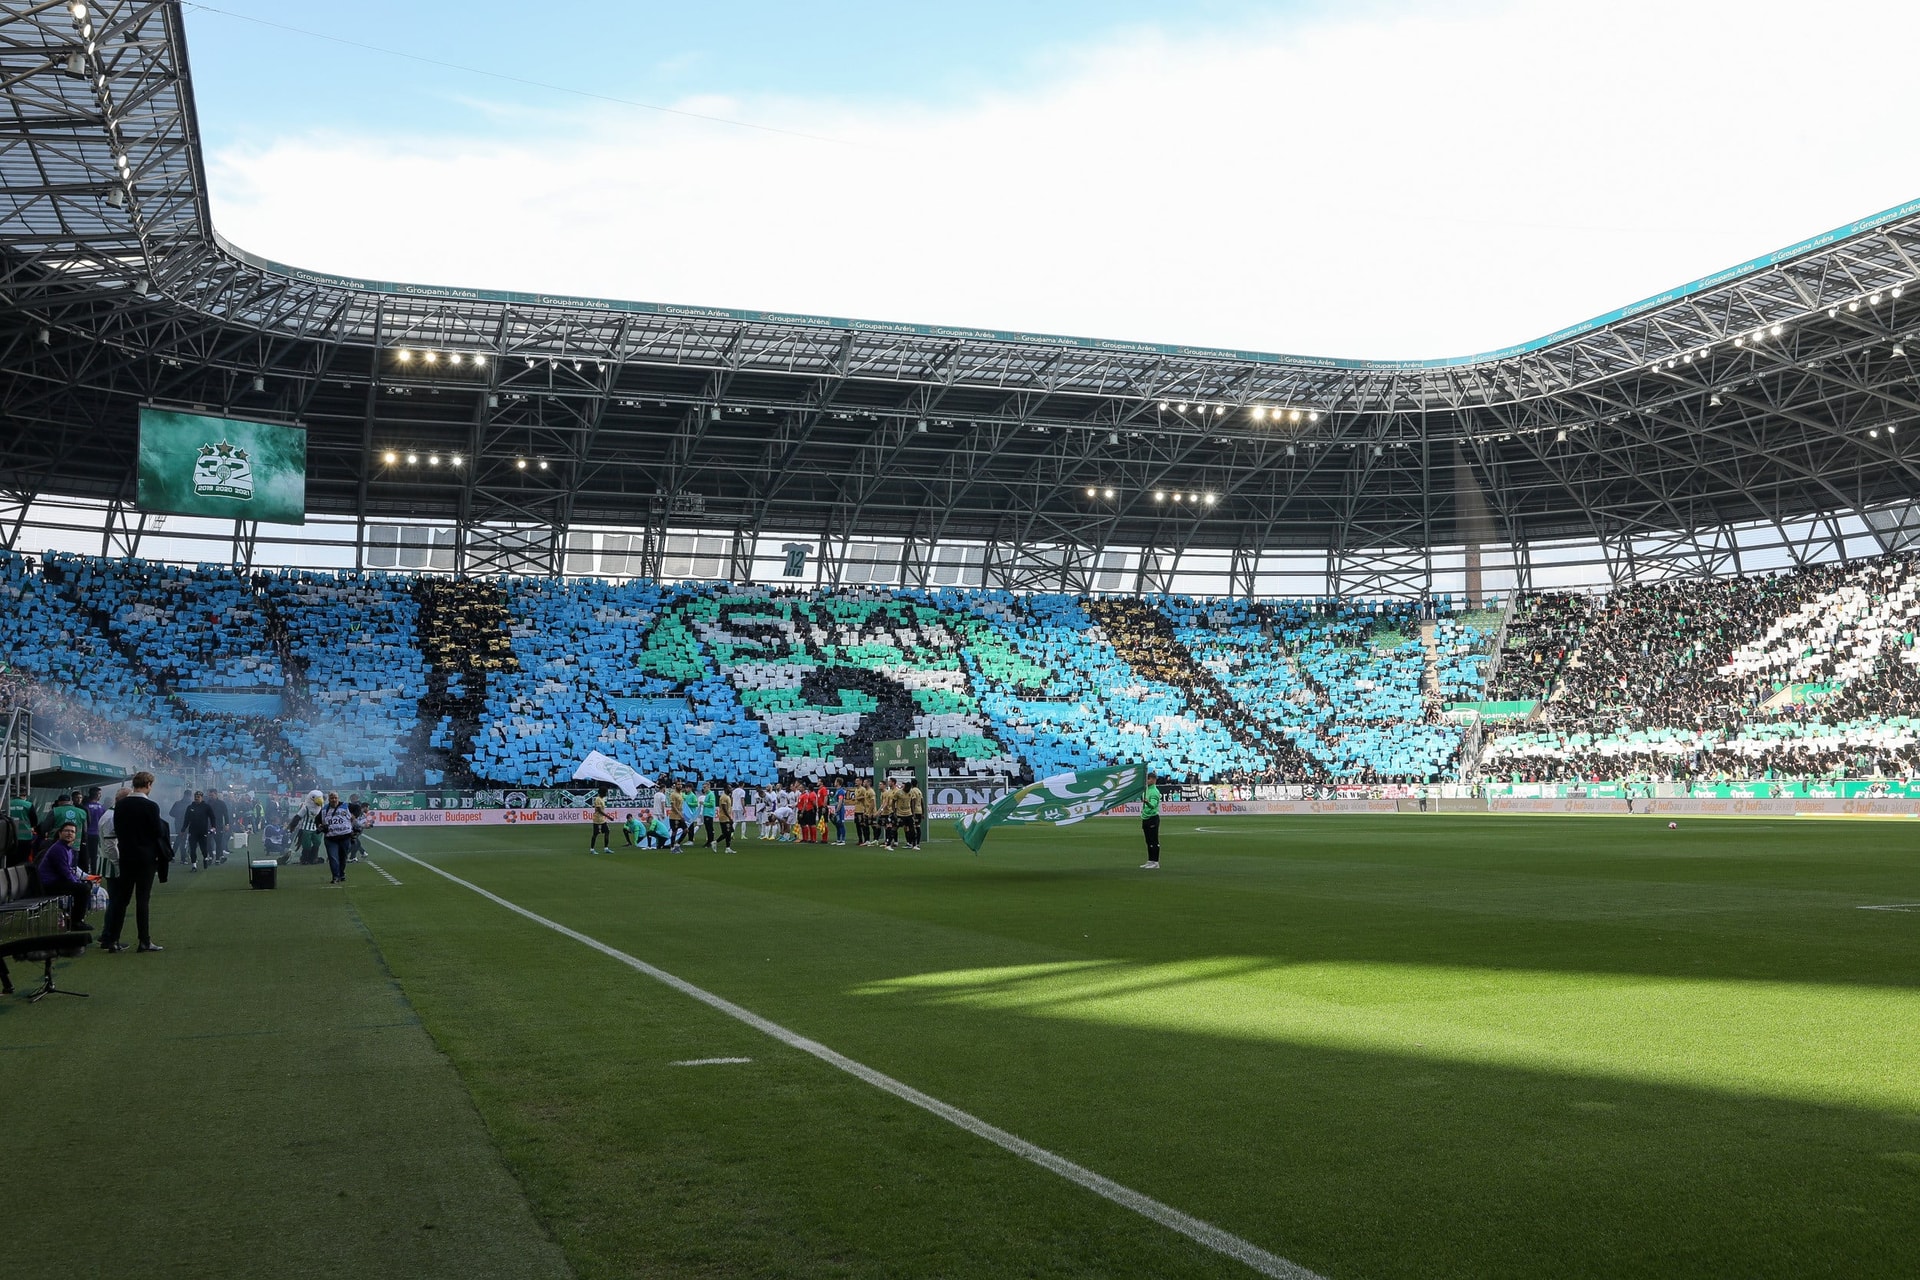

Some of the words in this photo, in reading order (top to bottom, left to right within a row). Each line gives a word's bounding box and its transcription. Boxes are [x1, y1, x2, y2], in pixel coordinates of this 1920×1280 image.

[1860, 212, 1898, 229] Groupama
[1778, 244, 1812, 259] Groupama
[297, 271, 338, 285] Groupama
[340, 279, 365, 288] Aréna
[1704, 271, 1736, 285] Groupama
[406, 286, 450, 296] Groupama
[452, 290, 477, 298] Aréna
[543, 297, 585, 307] Groupama
[586, 301, 610, 309] Aréna
[666, 307, 705, 316] Groupama
[769, 315, 807, 324] Groupama
[856, 322, 893, 331] Groupama
[938, 329, 973, 337] Groupama
[1022, 335, 1056, 344] Groupama
[1102, 342, 1136, 350] Groupama
[1184, 348, 1217, 357] Groupama
[1285, 357, 1317, 365] Groupama
[195, 455, 252, 489] 32
[790, 551, 805, 568] 12
[1161, 803, 1191, 813] Budapest
[1219, 803, 1247, 813] hufbau
[1267, 802, 1296, 813] Budapest
[1322, 801, 1349, 811] hufbau
[1368, 800, 1395, 811] Budapest
[1658, 801, 1682, 811] hufbau
[1746, 801, 1773, 811] hufbau
[1795, 801, 1824, 812] Budapest
[1856, 801, 1888, 812] hufbau
[1890, 802, 1911, 812] akker
[379, 812, 416, 822] hufbau
[420, 812, 442, 822] akker
[445, 811, 482, 823] Budapest
[520, 811, 555, 821] hufbau
[558, 811, 580, 821] akker
